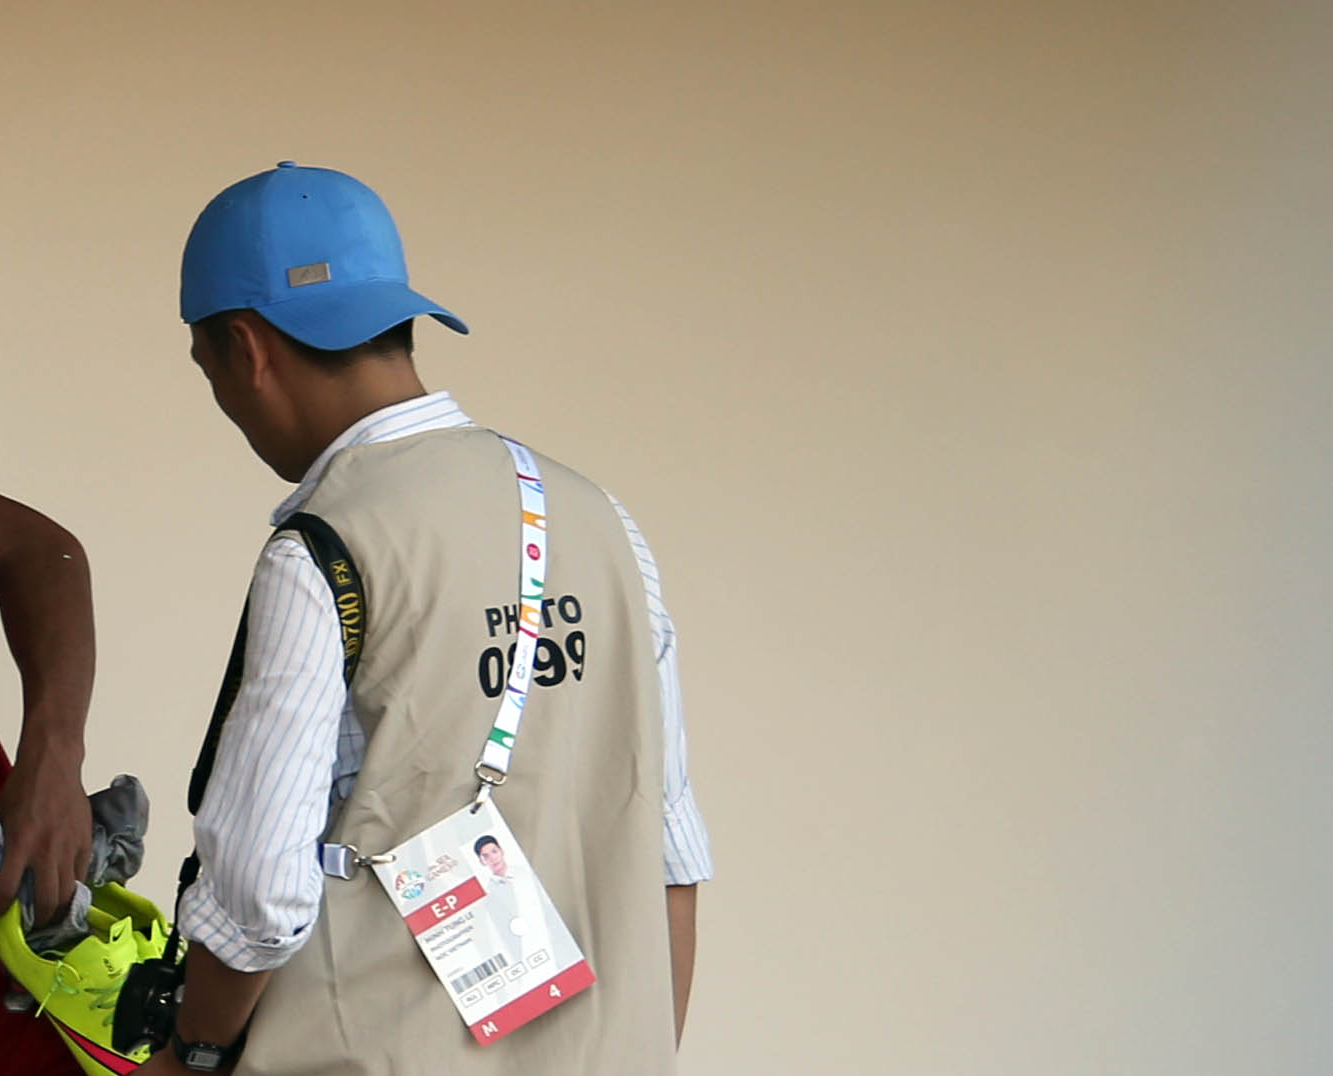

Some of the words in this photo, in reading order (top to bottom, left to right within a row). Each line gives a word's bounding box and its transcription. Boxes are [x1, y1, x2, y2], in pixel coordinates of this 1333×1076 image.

[333, 563, 352, 585] FX
[485, 595, 582, 637] PHTO
[430, 895, 458, 919] E-P
[549, 984, 562, 998] 4
[481, 1021, 499, 1038] M
